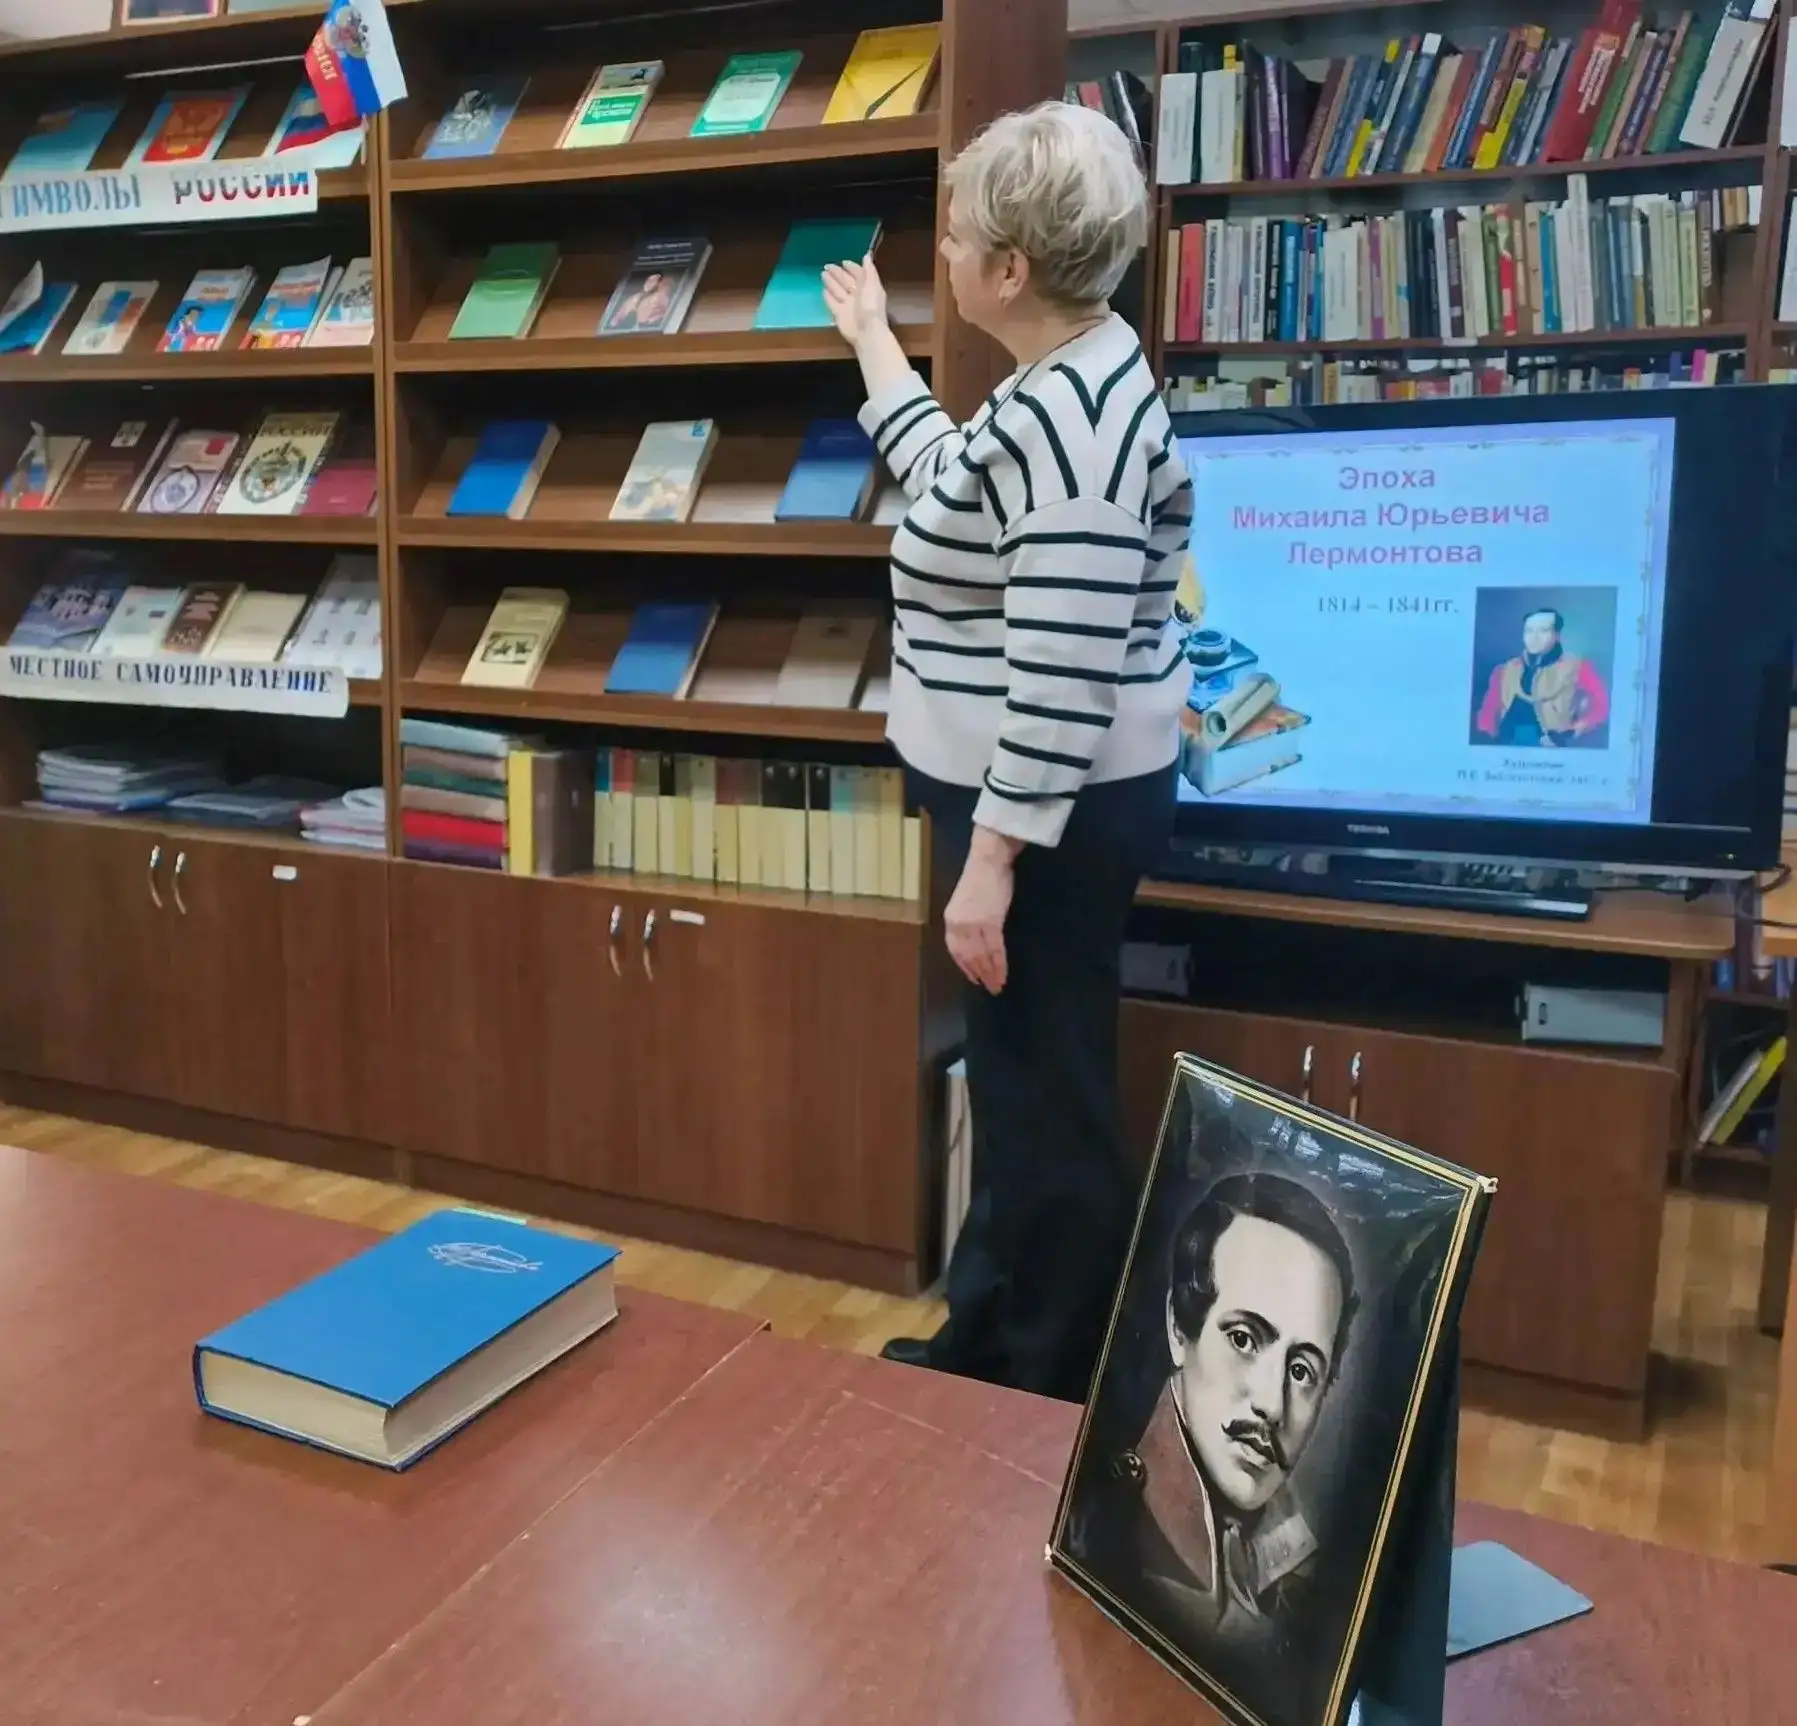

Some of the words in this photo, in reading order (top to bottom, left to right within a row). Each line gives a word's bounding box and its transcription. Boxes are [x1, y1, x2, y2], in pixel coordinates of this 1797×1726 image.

[0, 174, 142, 218] ИМВОЛЫ
[173, 168, 310, 205] РОССИИ
[1338, 466, 1436, 491] Эпоха
[1232, 505, 1368, 531] Михаила
[1376, 502, 1551, 533] Юрьевича
[1286, 541, 1484, 571] Лермонтова
[1317, 596, 1362, 614] 1814
[9, 653, 103, 681] МЕСТНОЕ
[116, 662, 334, 694] САМОУПРАВЛЕНИЕ
